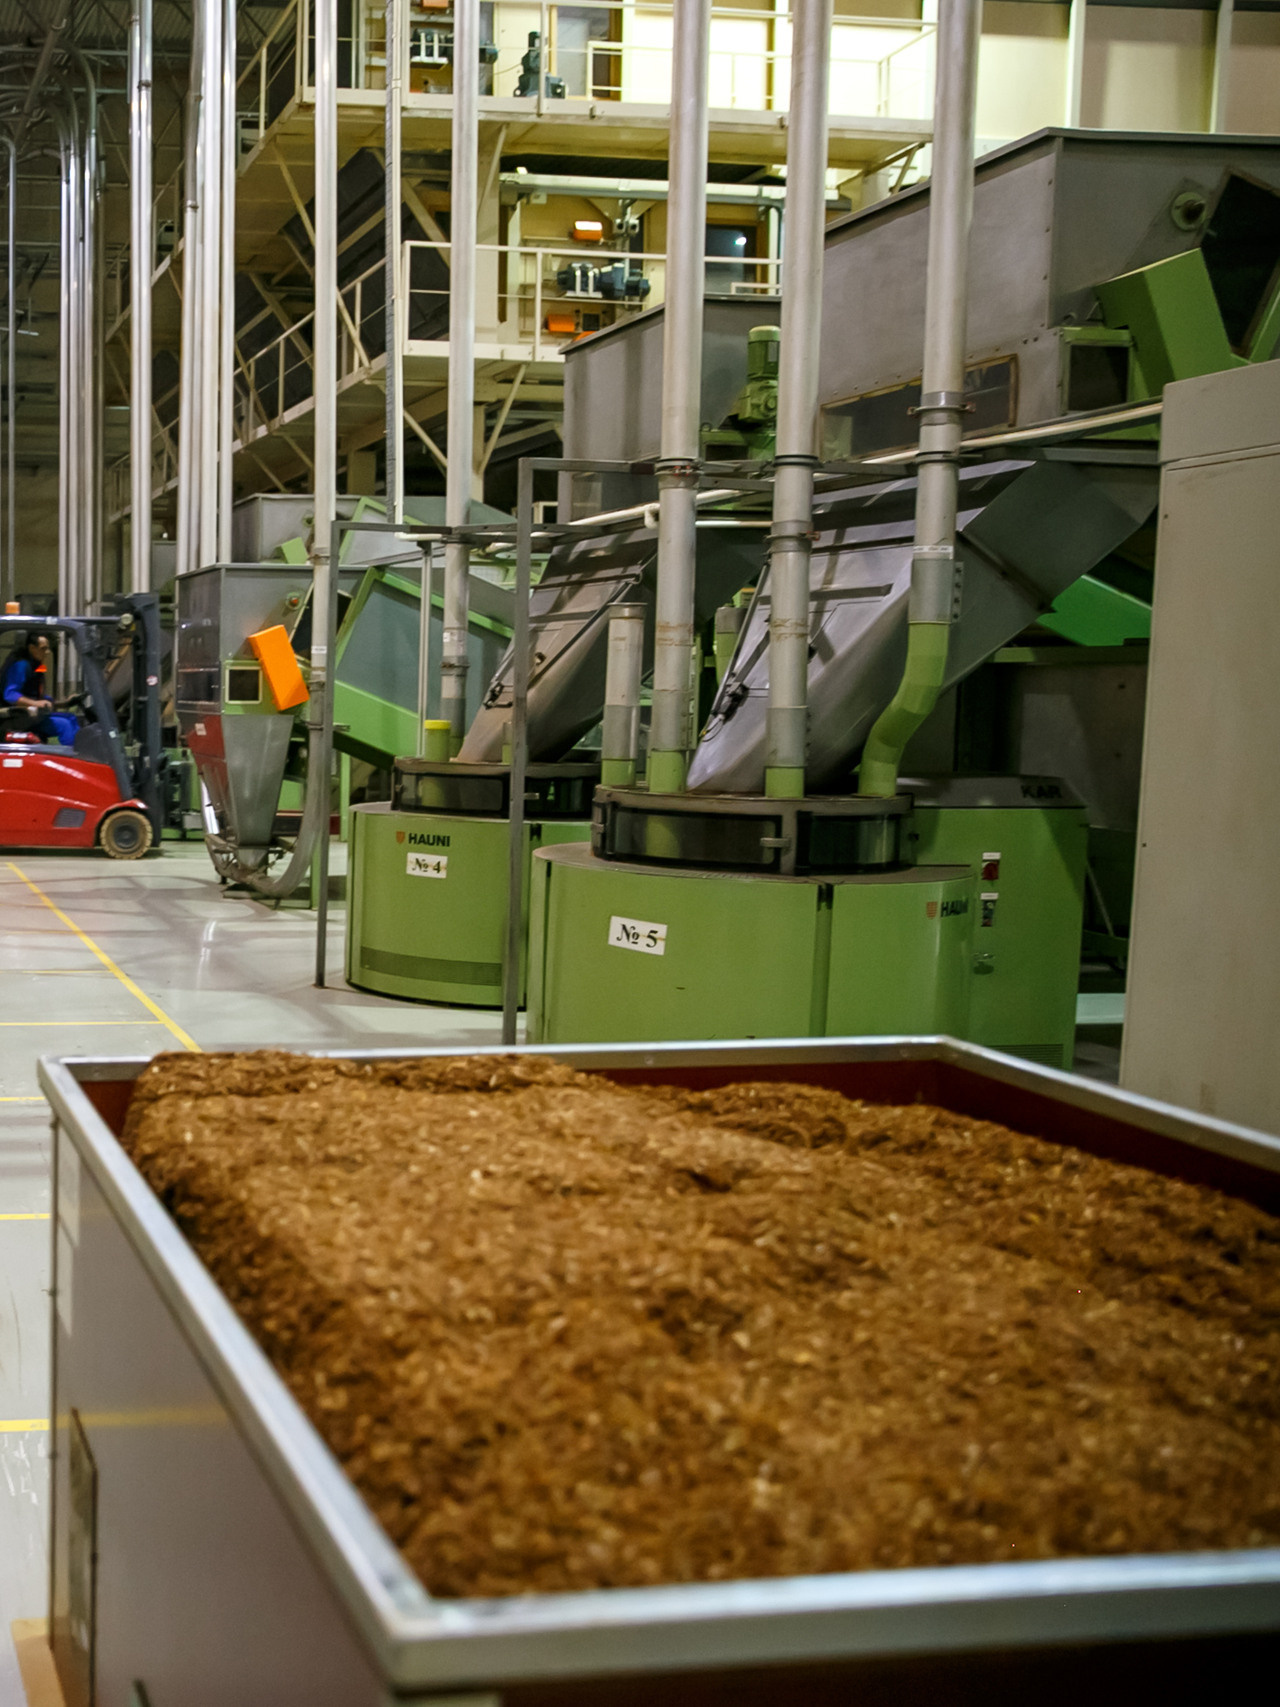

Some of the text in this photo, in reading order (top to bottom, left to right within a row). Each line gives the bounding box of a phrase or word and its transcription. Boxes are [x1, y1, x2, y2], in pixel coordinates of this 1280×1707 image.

[408, 833, 451, 847] HAUNI
[432, 861, 441, 874] 4
[646, 929, 659, 948] 5
